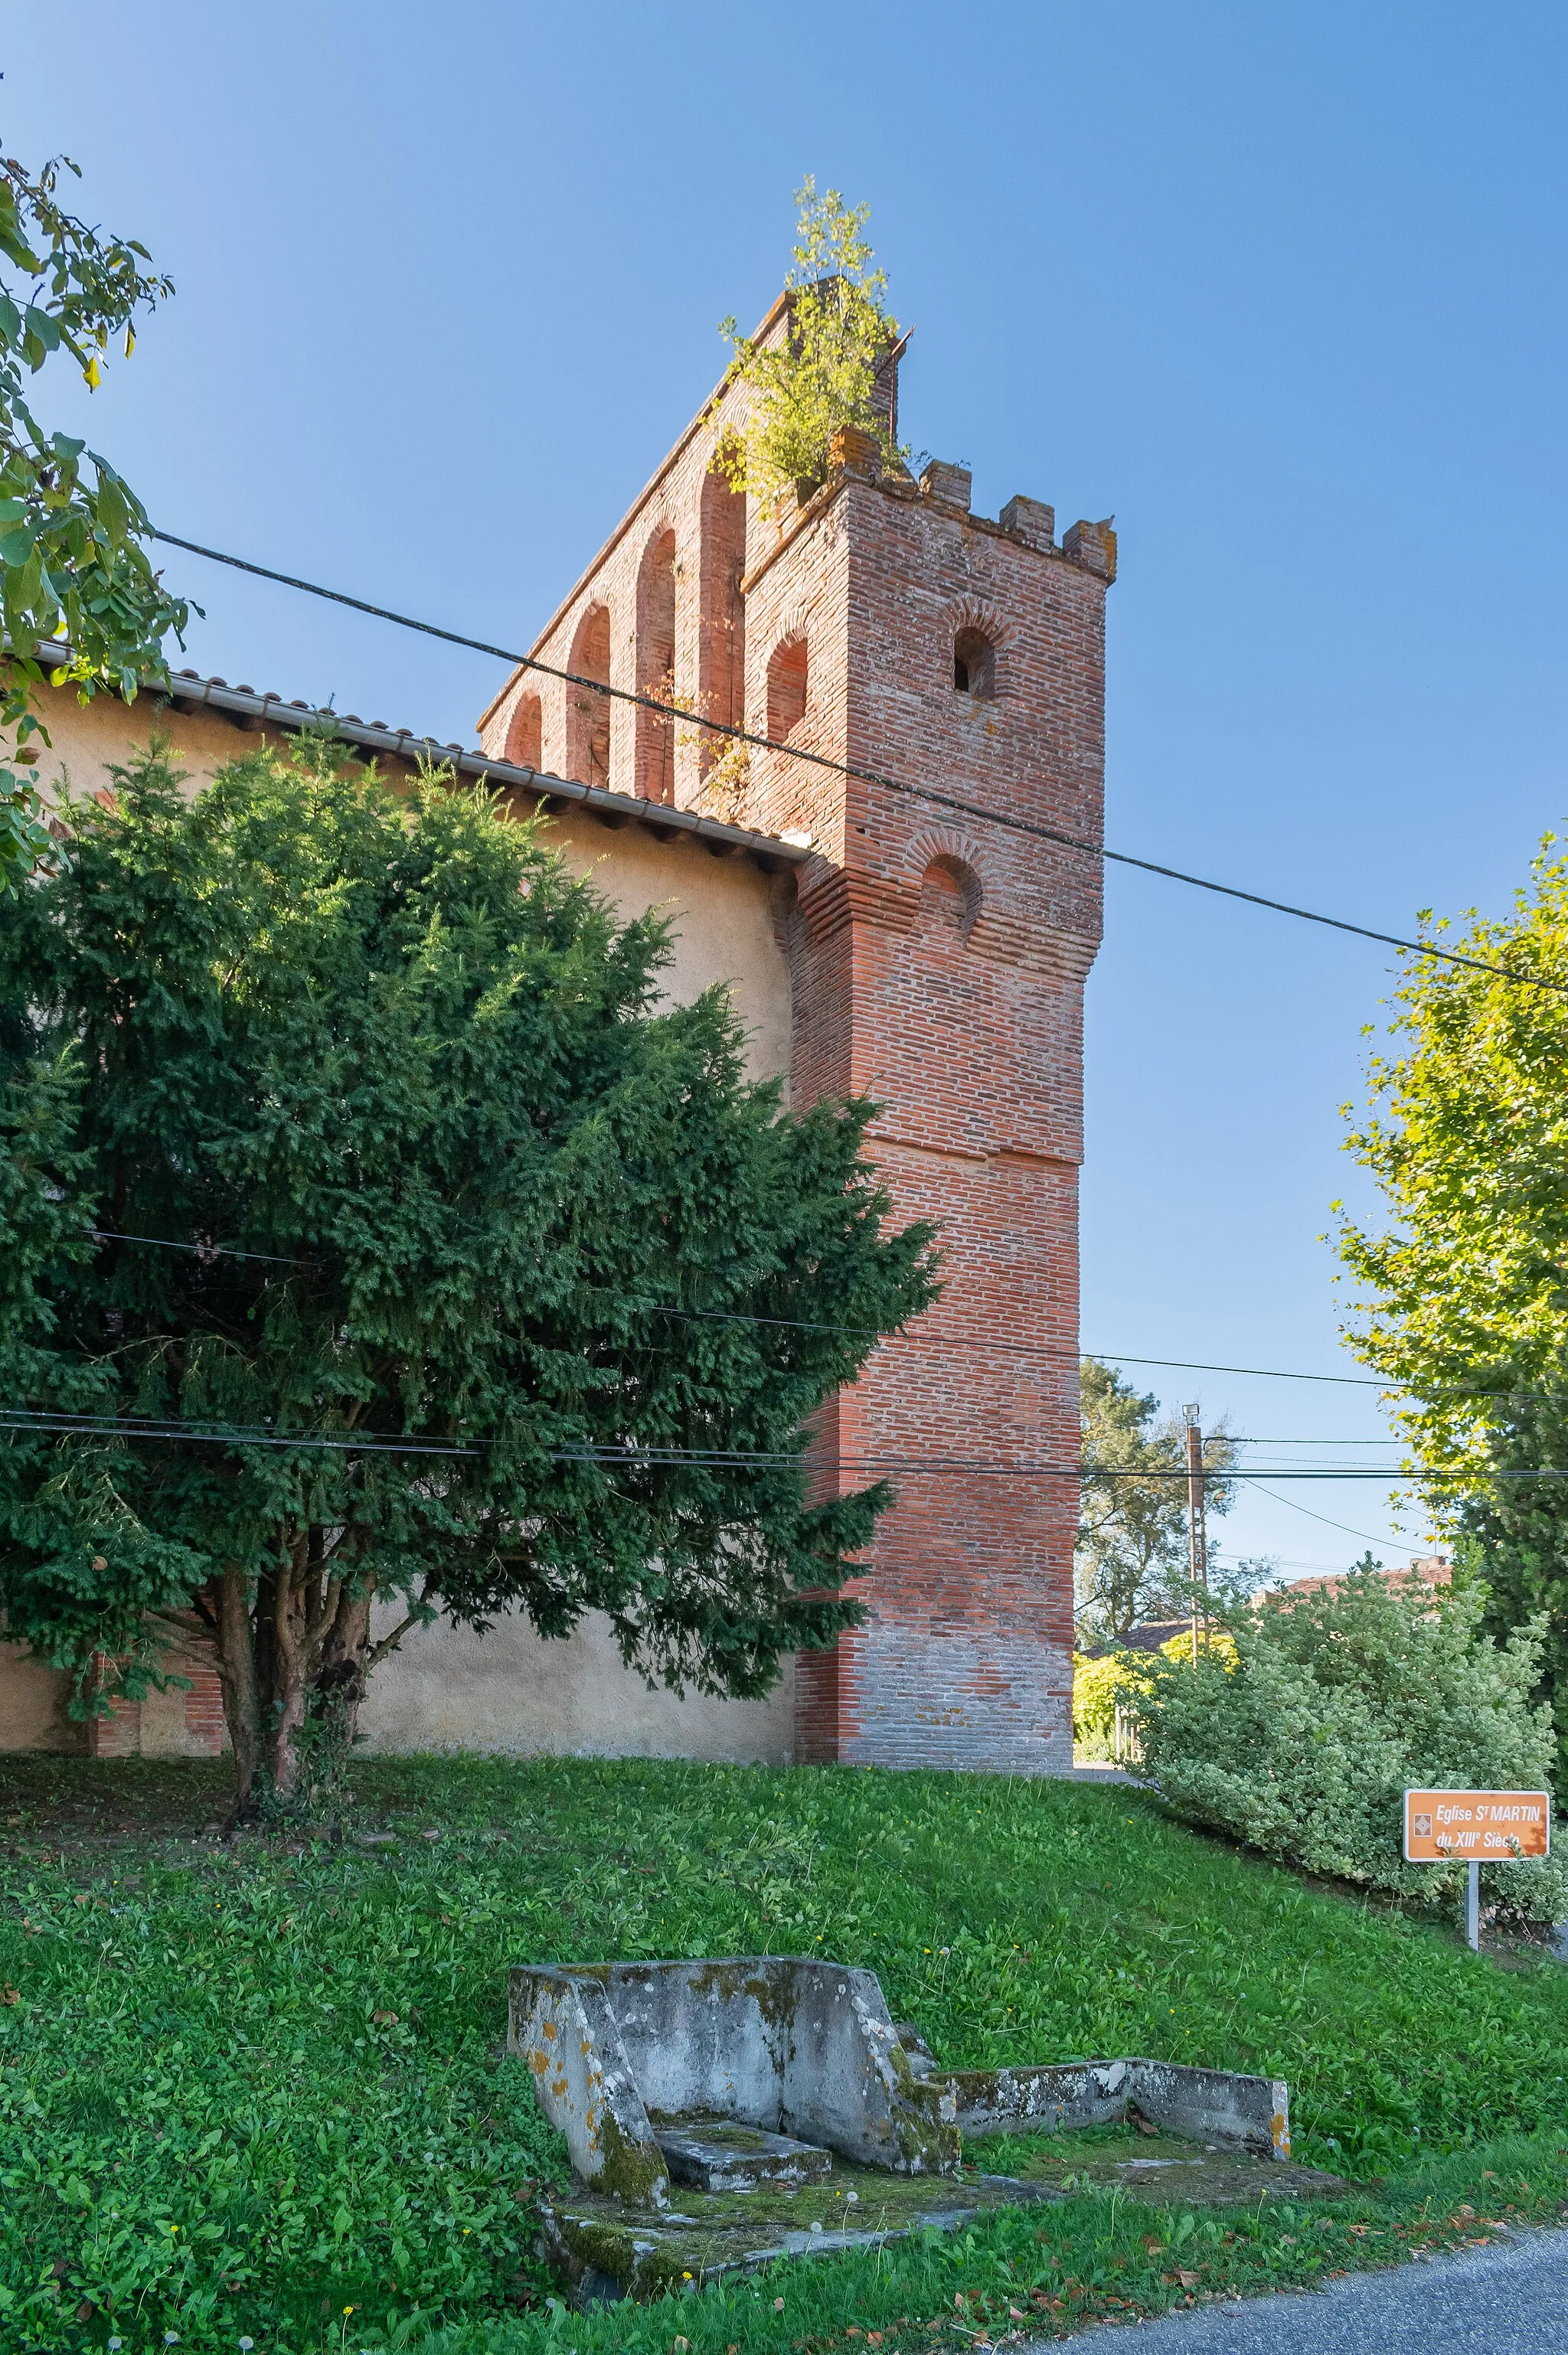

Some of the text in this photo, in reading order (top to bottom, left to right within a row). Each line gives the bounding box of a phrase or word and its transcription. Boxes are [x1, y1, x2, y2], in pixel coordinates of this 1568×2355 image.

[1436, 1805, 1540, 1825] Eglise ST MARTIN
[1436, 1831, 1452, 1847] du
[1455, 1831, 1481, 1847] XIIIe
